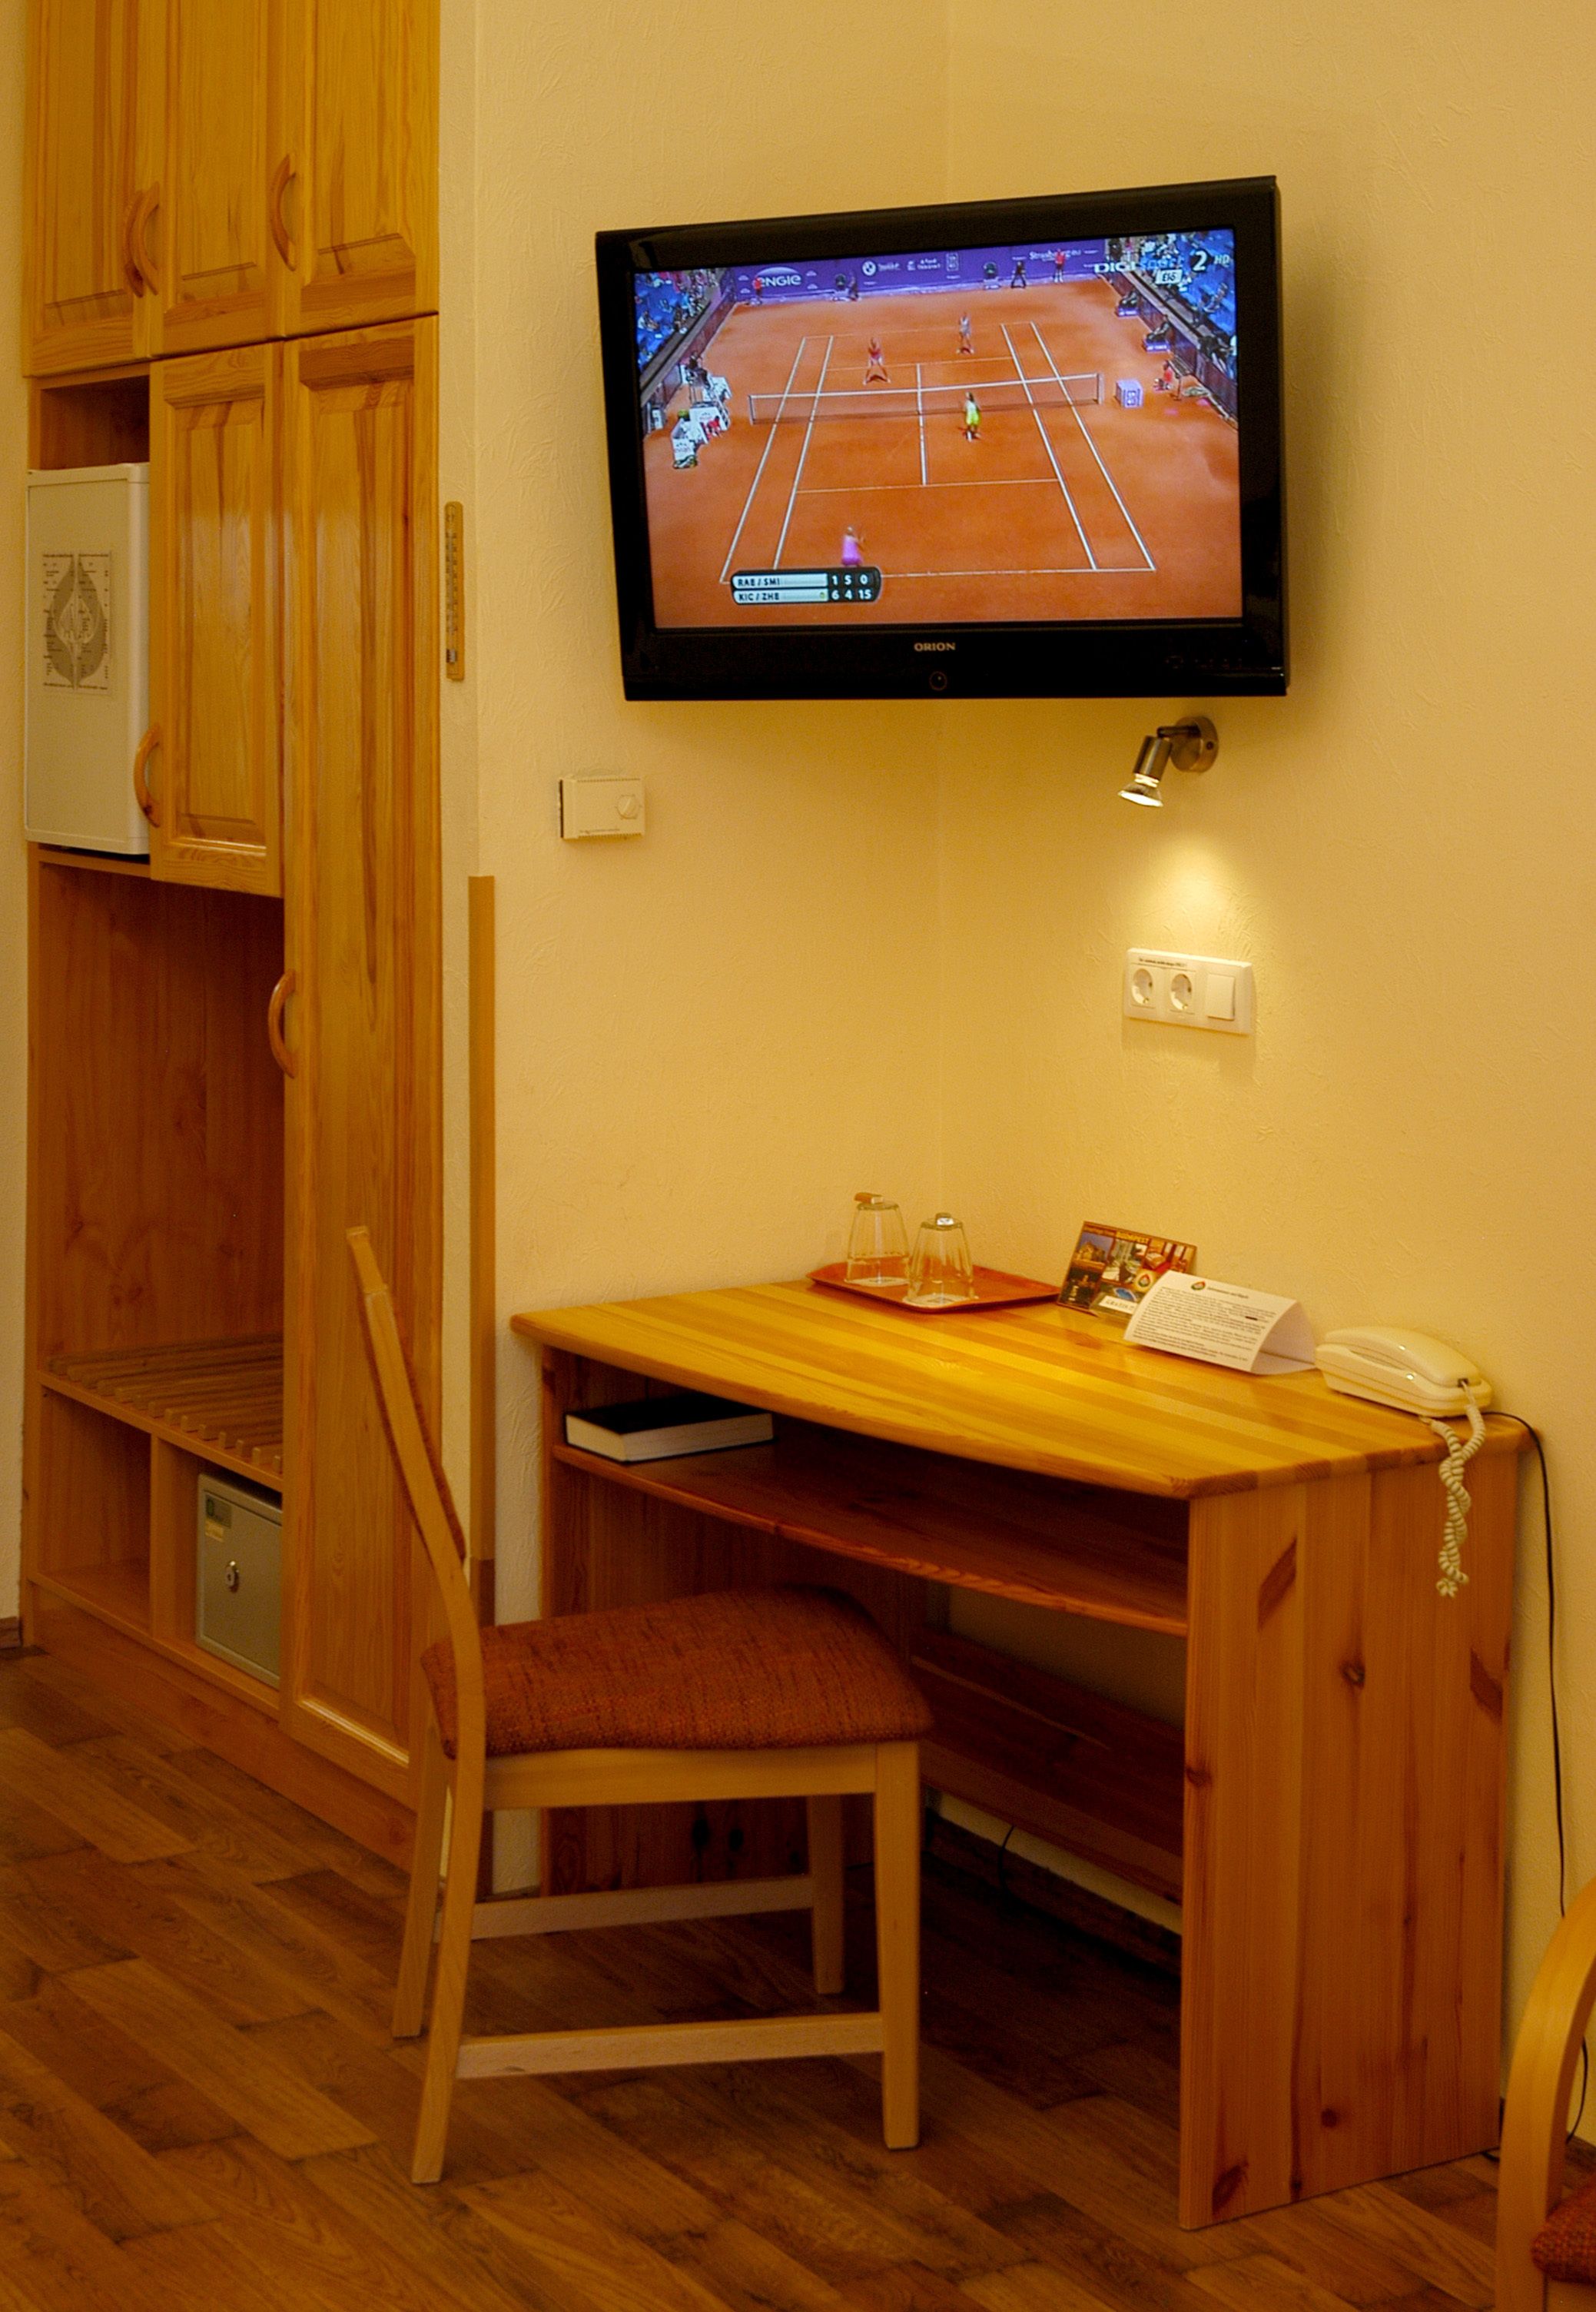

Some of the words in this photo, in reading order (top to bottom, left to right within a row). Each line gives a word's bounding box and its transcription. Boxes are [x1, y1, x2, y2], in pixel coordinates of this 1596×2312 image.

[1193, 250, 1208, 271] 2
[738, 578, 755, 586] RAE
[764, 577, 780, 586] SMI
[831, 575, 838, 586] 1
[860, 575, 868, 585] 0
[738, 593, 753, 602] KIC
[762, 592, 780, 601] ZHE
[831, 590, 840, 600] 6
[844, 590, 853, 600] 4
[858, 589, 872, 600] 15
[914, 642, 956, 652] ORION
